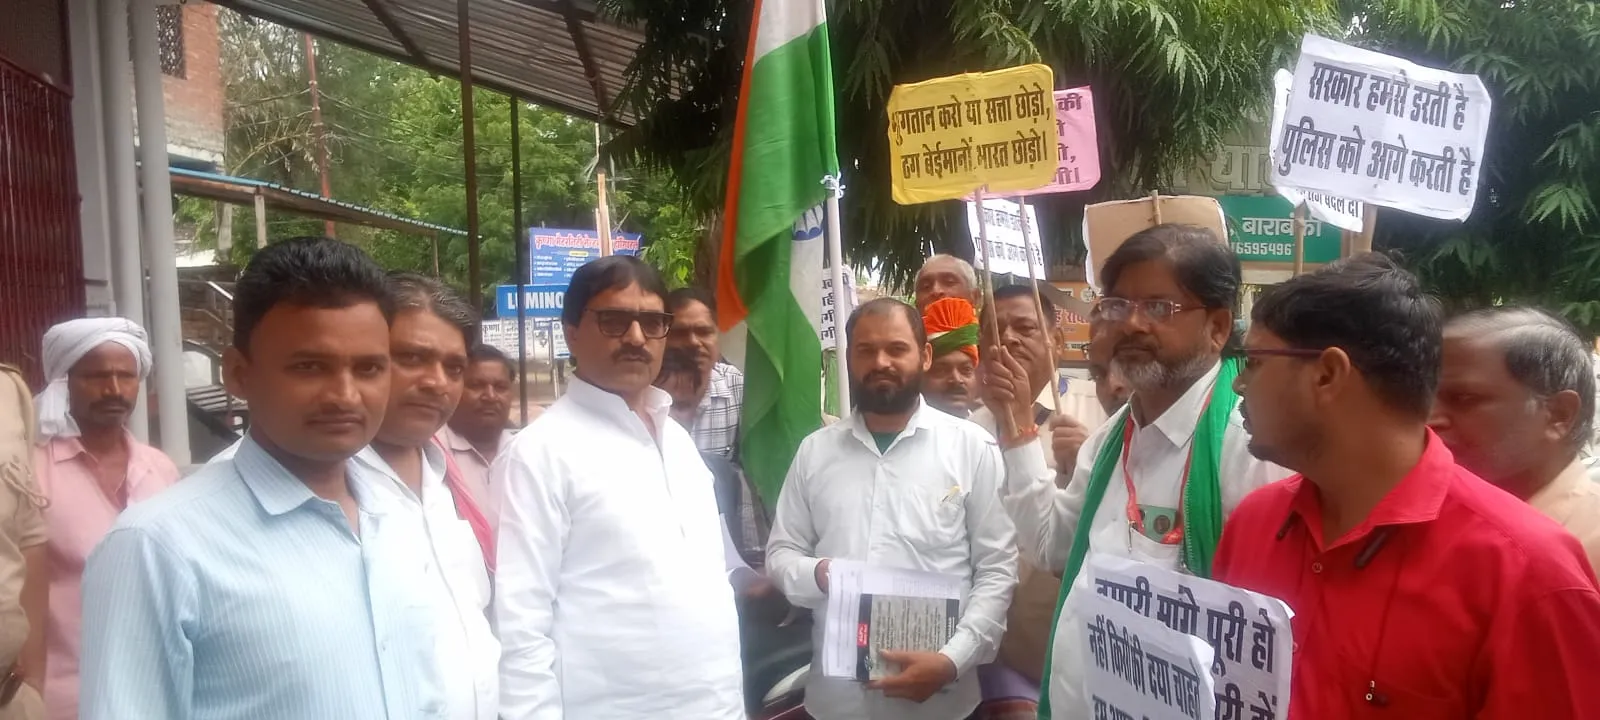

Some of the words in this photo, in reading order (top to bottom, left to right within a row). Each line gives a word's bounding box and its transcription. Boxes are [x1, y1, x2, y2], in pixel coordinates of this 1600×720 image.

[937, 94, 962, 129] करो
[965, 99, 981, 125] या
[983, 95, 1012, 124] सत्ता
[1308, 61, 1367, 109] सरकार
[1366, 69, 1411, 118] हमसे
[1410, 81, 1452, 129] डरती
[1452, 83, 1469, 131] है
[922, 137, 972, 179] बेईमानों
[976, 141, 1009, 169] भारत
[1278, 115, 1337, 176] पुलिस
[1336, 125, 1366, 175] को
[1366, 133, 1408, 184] आगे
[1408, 146, 1457, 193] करती
[1458, 147, 1475, 195] है
[1231, 242, 1296, 256] 6595496
[1206, 601, 1247, 677] पूरी
[1252, 608, 1276, 673] हो
[1145, 652, 1172, 706] दया
